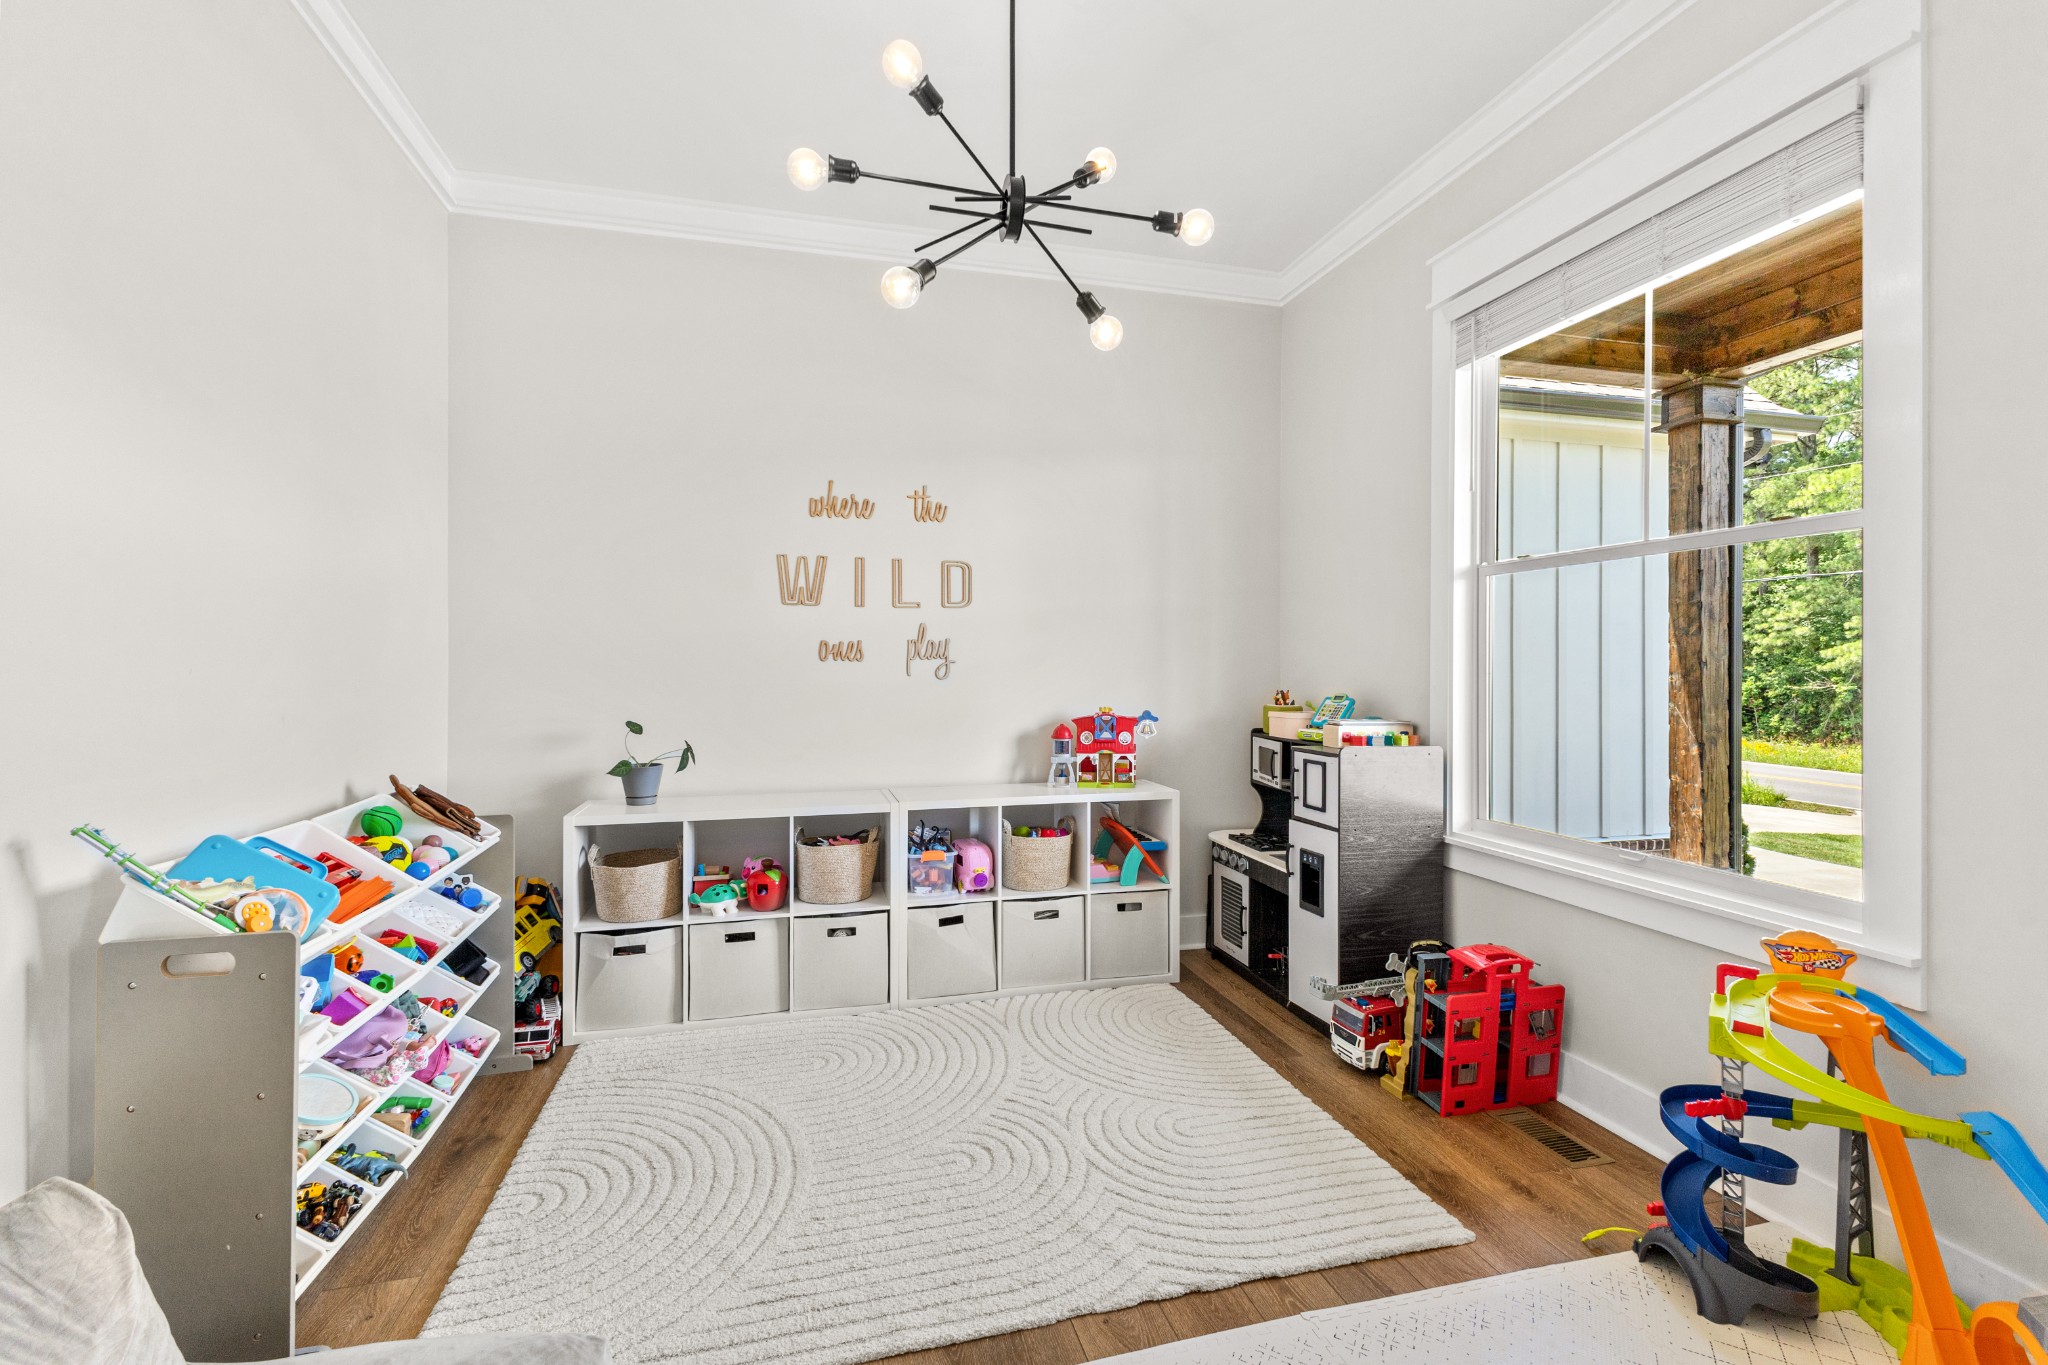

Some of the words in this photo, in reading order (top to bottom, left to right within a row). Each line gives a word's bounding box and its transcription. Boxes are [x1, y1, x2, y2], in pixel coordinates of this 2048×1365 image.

[808, 480, 875, 519] where
[906, 485, 947, 522] the
[776, 554, 972, 608] WILD
[818, 640, 865, 662] ones
[906, 622, 956, 680] play
